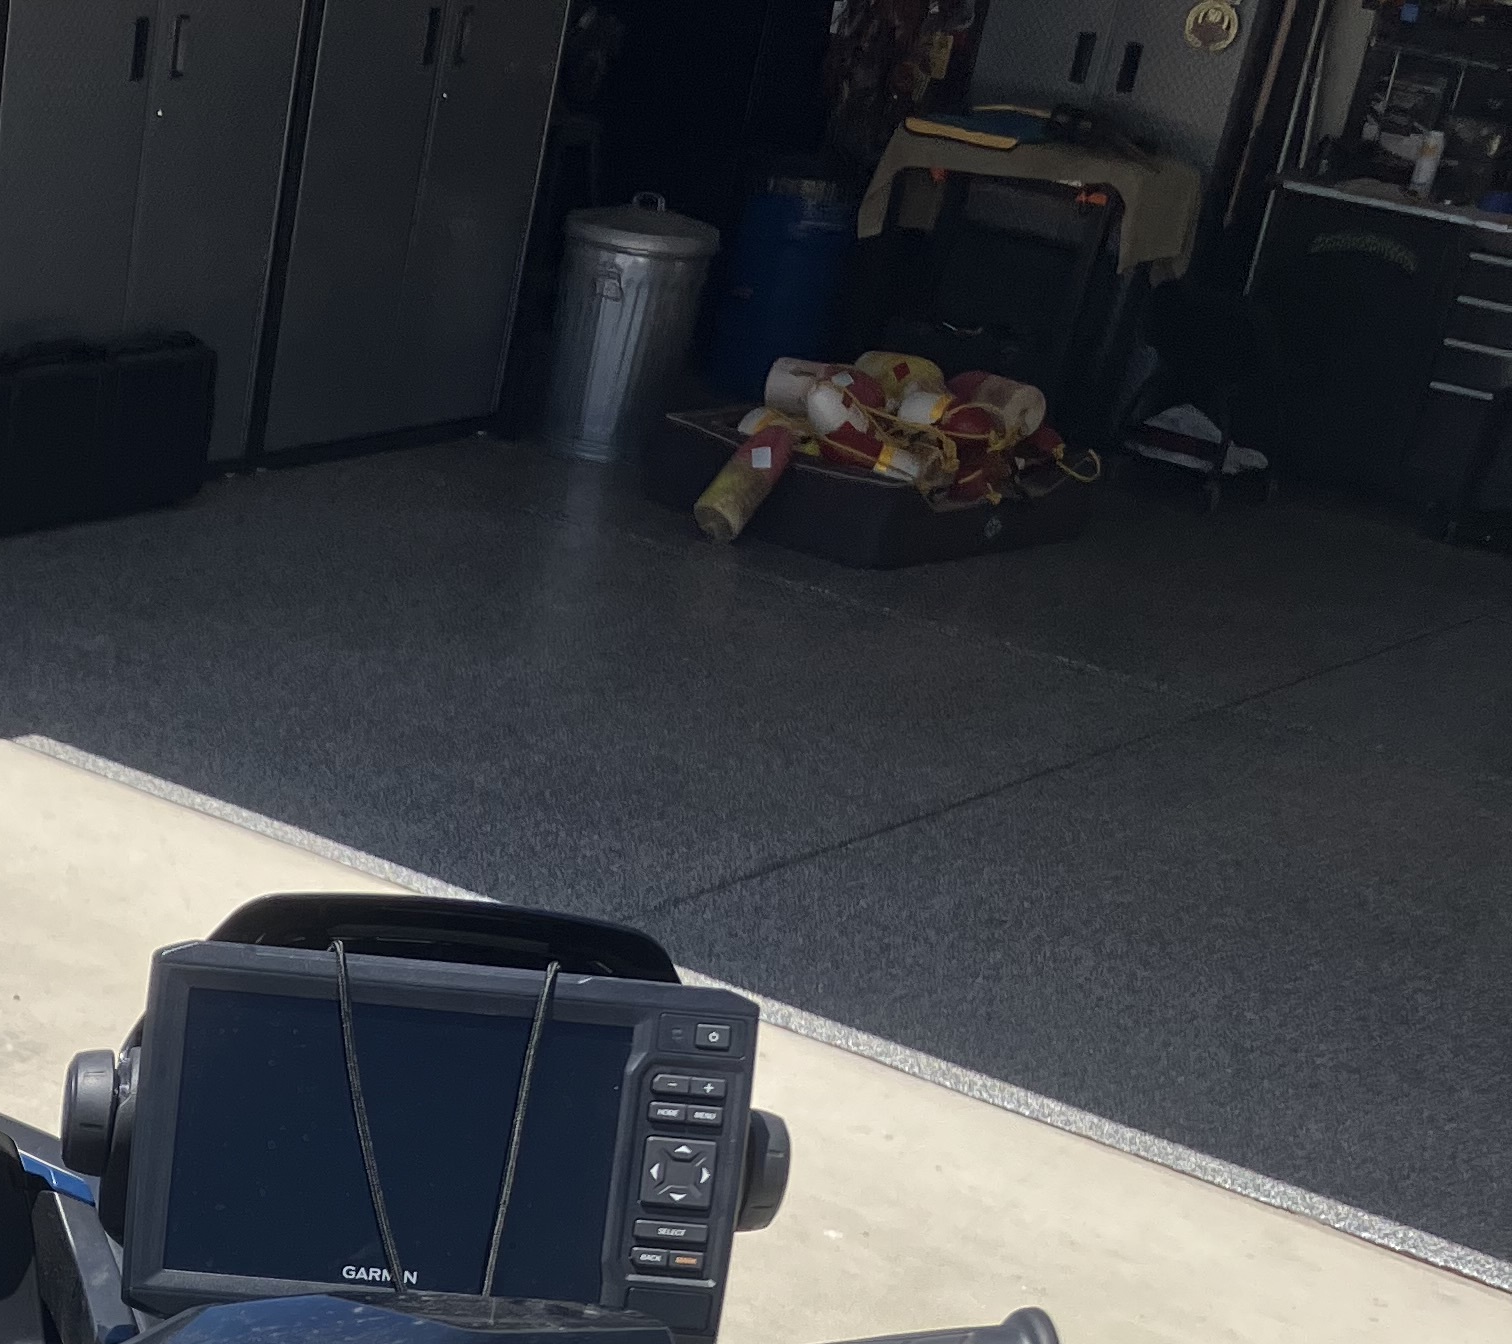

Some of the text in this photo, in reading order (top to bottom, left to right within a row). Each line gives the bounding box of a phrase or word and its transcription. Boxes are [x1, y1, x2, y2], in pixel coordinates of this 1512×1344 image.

[657, 1227, 687, 1237] SELECT
[639, 1253, 662, 1262] BACK
[342, 1265, 418, 1286] GARMN
